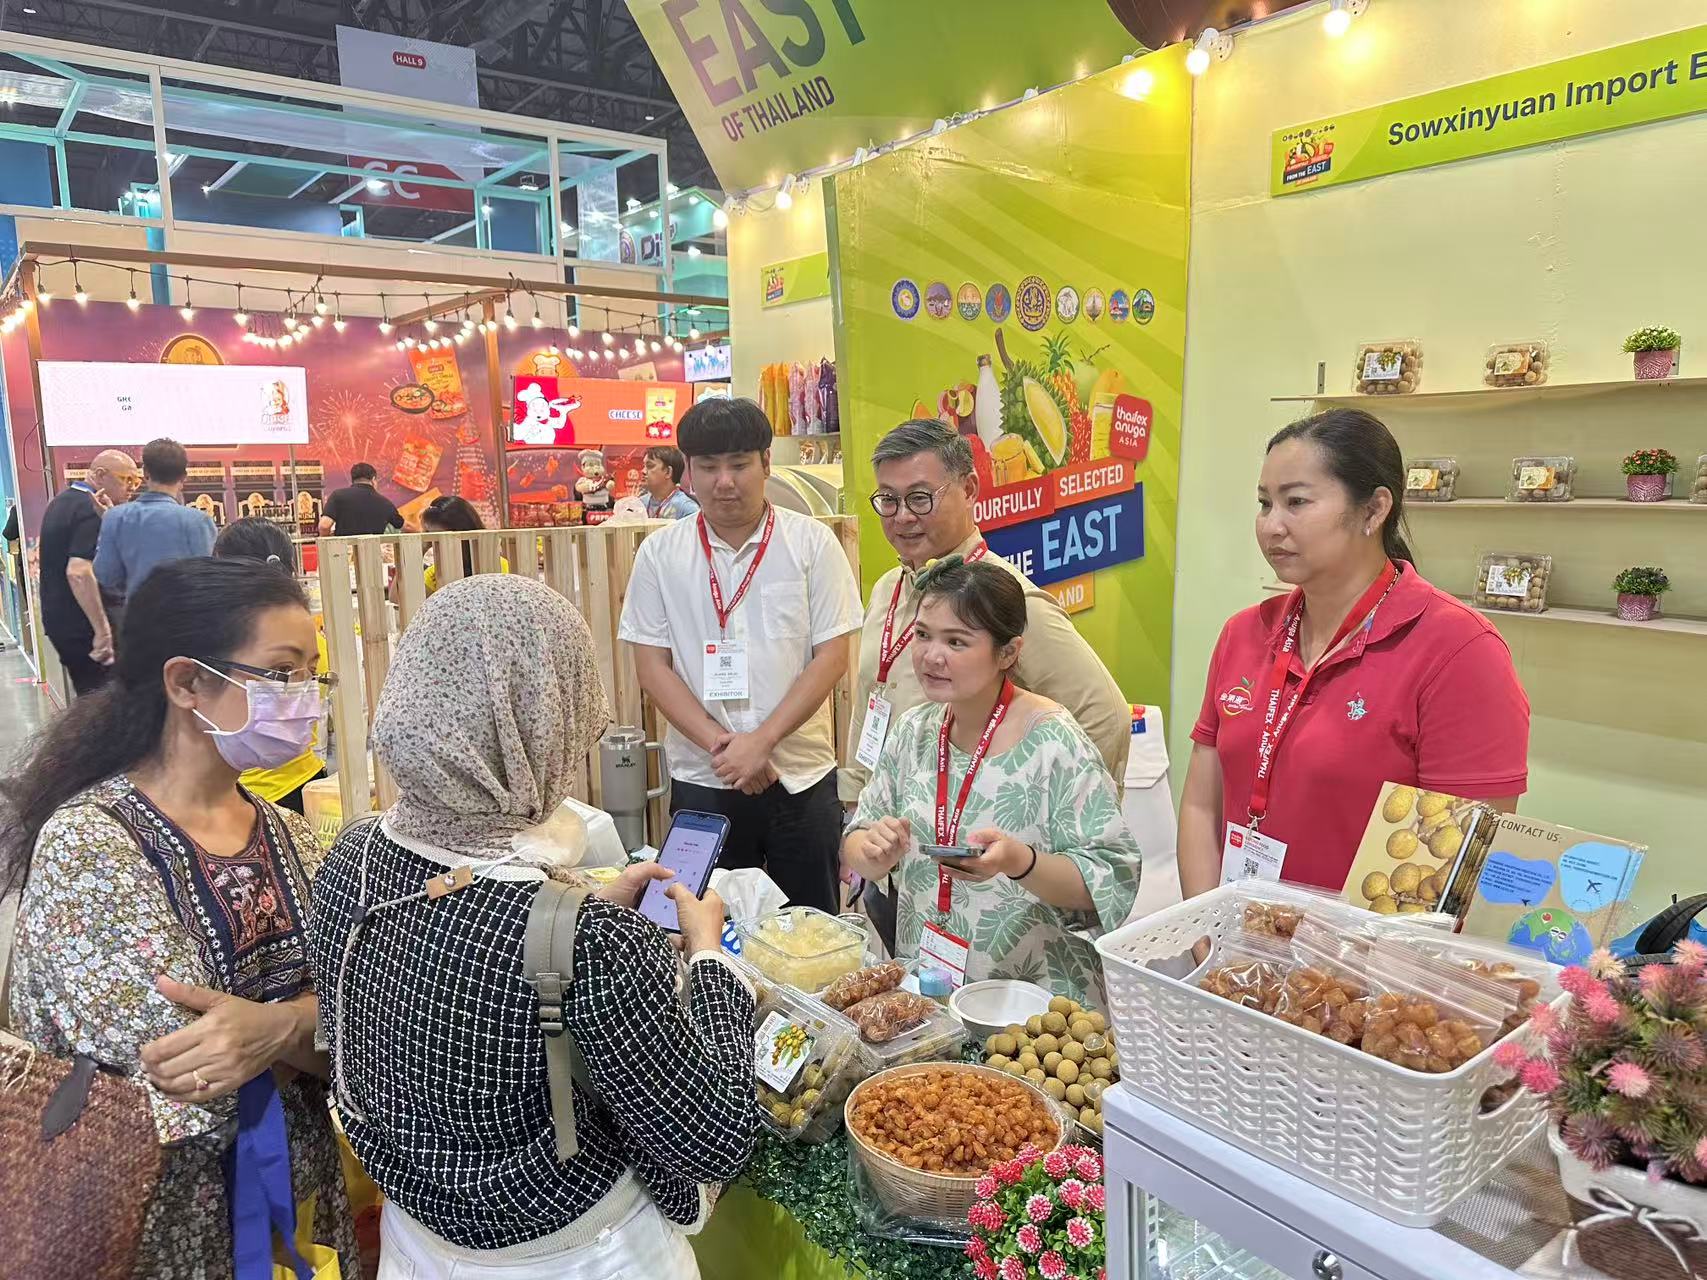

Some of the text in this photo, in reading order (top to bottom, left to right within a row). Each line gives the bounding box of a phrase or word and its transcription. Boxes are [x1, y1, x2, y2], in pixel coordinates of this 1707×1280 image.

[396, 54, 423, 66] HALL 9
[721, 76, 835, 142] OF THAILAND
[1388, 92, 1555, 146] Sowxinyuan
[1565, 60, 1678, 108] Import
[1307, 161, 1326, 175] EAST
[1114, 420, 1146, 438] anuga
[1116, 405, 1148, 426] thaifex
[1118, 437, 1138, 447] ASIA
[973, 464, 1124, 523] OURFULLY SELECTED
[1041, 505, 1122, 572] EAST
[1057, 584, 1084, 608] AND
[1282, 614, 1301, 653] Anuga Asia
[1264, 688, 1280, 725] THAIFEX
[966, 744, 984, 775] THAIFEX
[983, 717, 997, 741] Anuga
[992, 703, 1005, 718] Asia
[1257, 743, 1274, 779] THAIFEX
[1273, 712, 1290, 738] Anuga
[1287, 693, 1299, 712] Asia
[937, 806, 945, 836] THAIFEX
[952, 807, 960, 825] Asia
[1500, 819, 1545, 839] CONTACT
